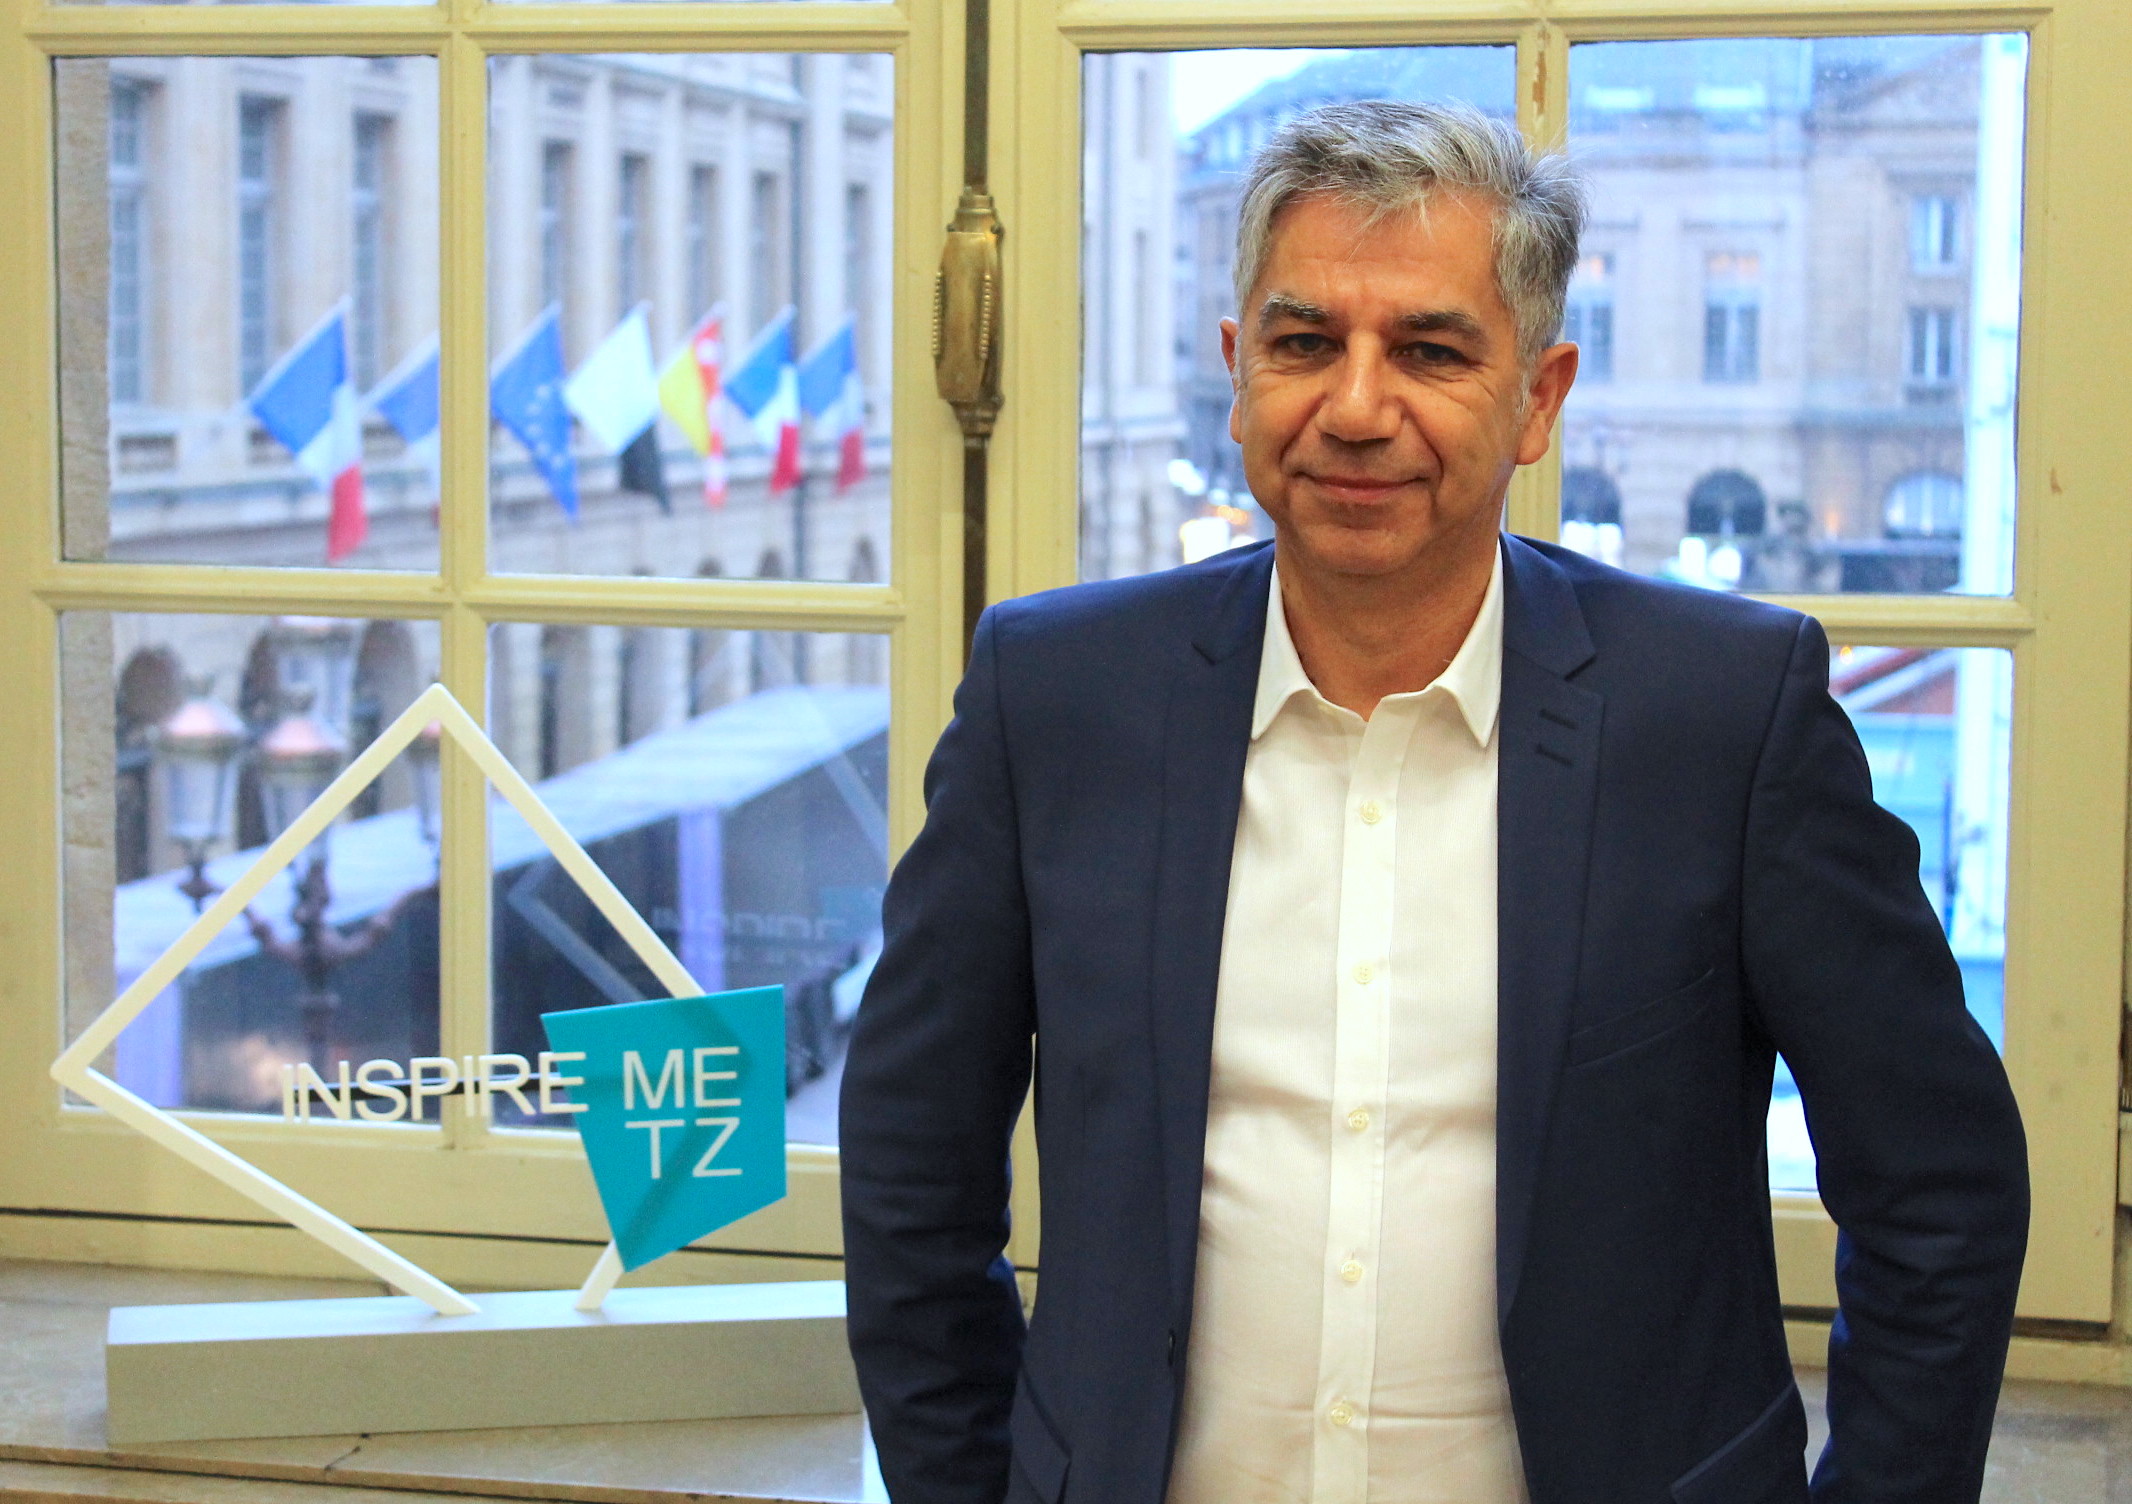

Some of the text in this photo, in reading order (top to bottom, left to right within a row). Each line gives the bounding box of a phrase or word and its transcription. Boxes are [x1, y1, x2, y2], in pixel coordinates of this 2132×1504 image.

[282, 1046, 742, 1123] INSPIRE ME
[625, 1117, 743, 1180] TZ
